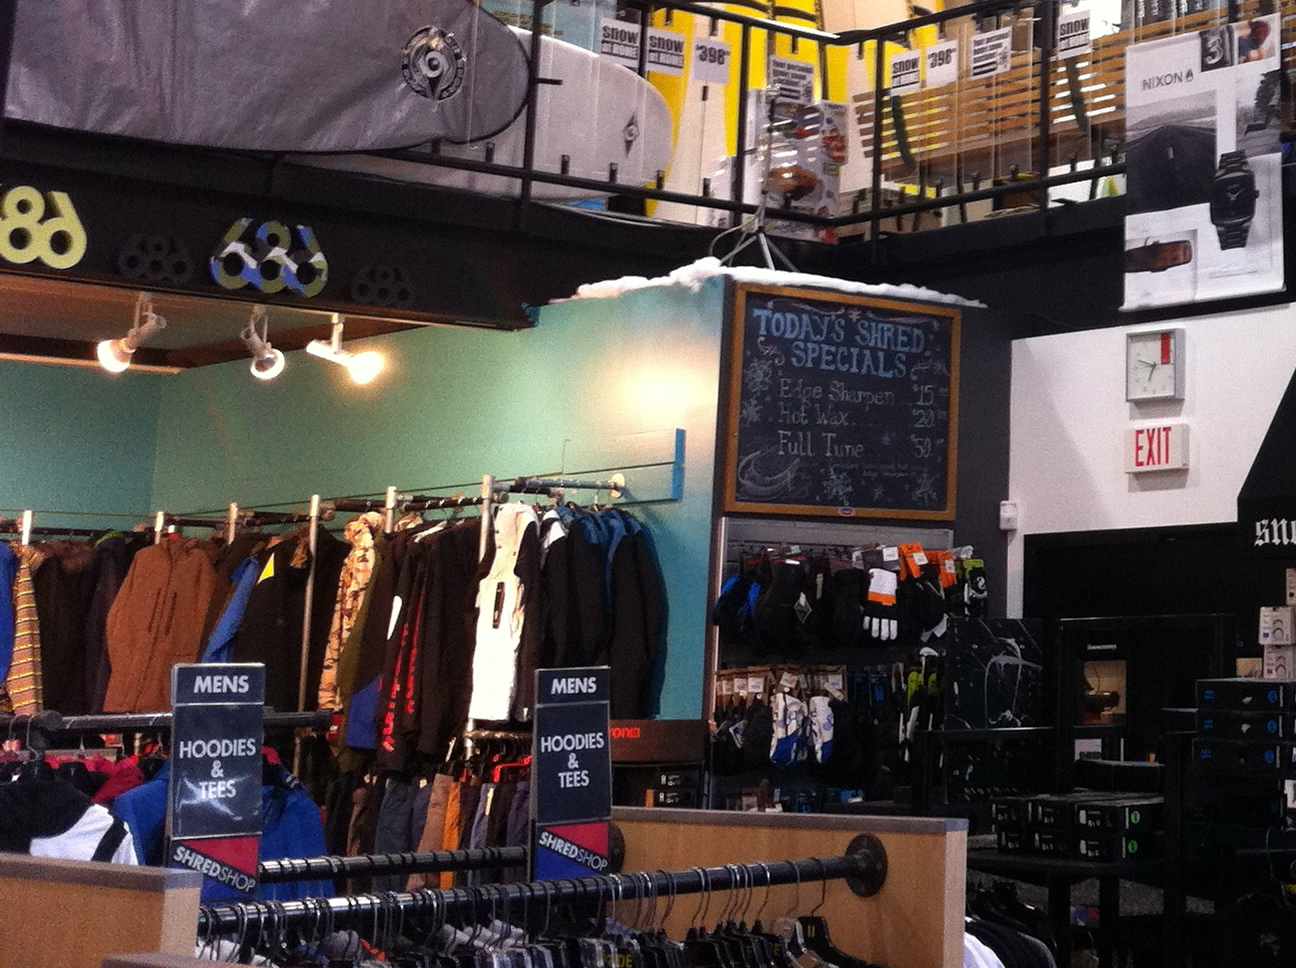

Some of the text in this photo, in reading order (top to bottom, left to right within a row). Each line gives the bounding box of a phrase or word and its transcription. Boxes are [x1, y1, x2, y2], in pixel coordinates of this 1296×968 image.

[1142, 71, 1183, 91] NIXON
[0, 185, 87, 270] 86
[753, 308, 926, 353] TODAY'S SHRED
[791, 341, 907, 379] SPECIALS
[778, 378, 823, 407] Edge
[828, 380, 895, 411] Sharpen
[778, 401, 810, 426] Hot
[778, 429, 815, 457] Full
[822, 432, 865, 458] Tune
[1134, 427, 1172, 467] EXIT
[193, 674, 250, 694] MENS
[550, 675, 597, 695] MENS
[179, 738, 257, 759] HOODIES
[539, 732, 605, 754] HOODIES
[210, 759, 225, 779] &
[567, 753, 580, 770] &
[199, 780, 238, 800] TEES
[558, 770, 590, 789] TEES
